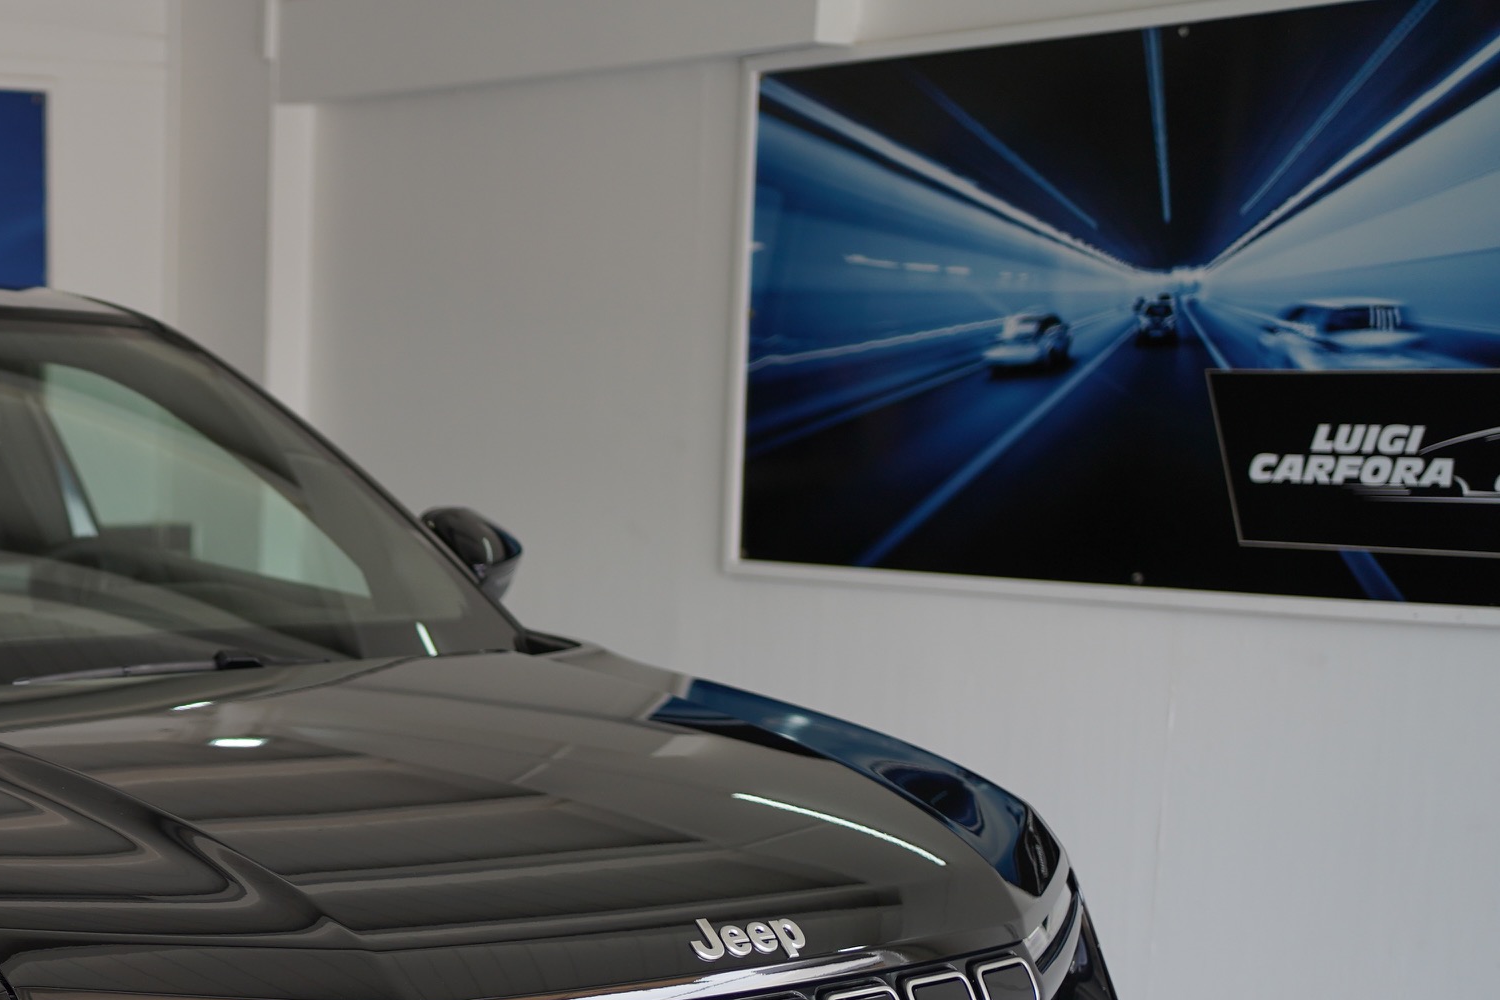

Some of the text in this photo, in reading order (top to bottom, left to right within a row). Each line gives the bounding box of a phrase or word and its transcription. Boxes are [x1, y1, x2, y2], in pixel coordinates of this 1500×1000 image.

[1310, 422, 1426, 456] LUIGI
[1248, 452, 1455, 488] CARFORA
[689, 918, 806, 962] Jeep
